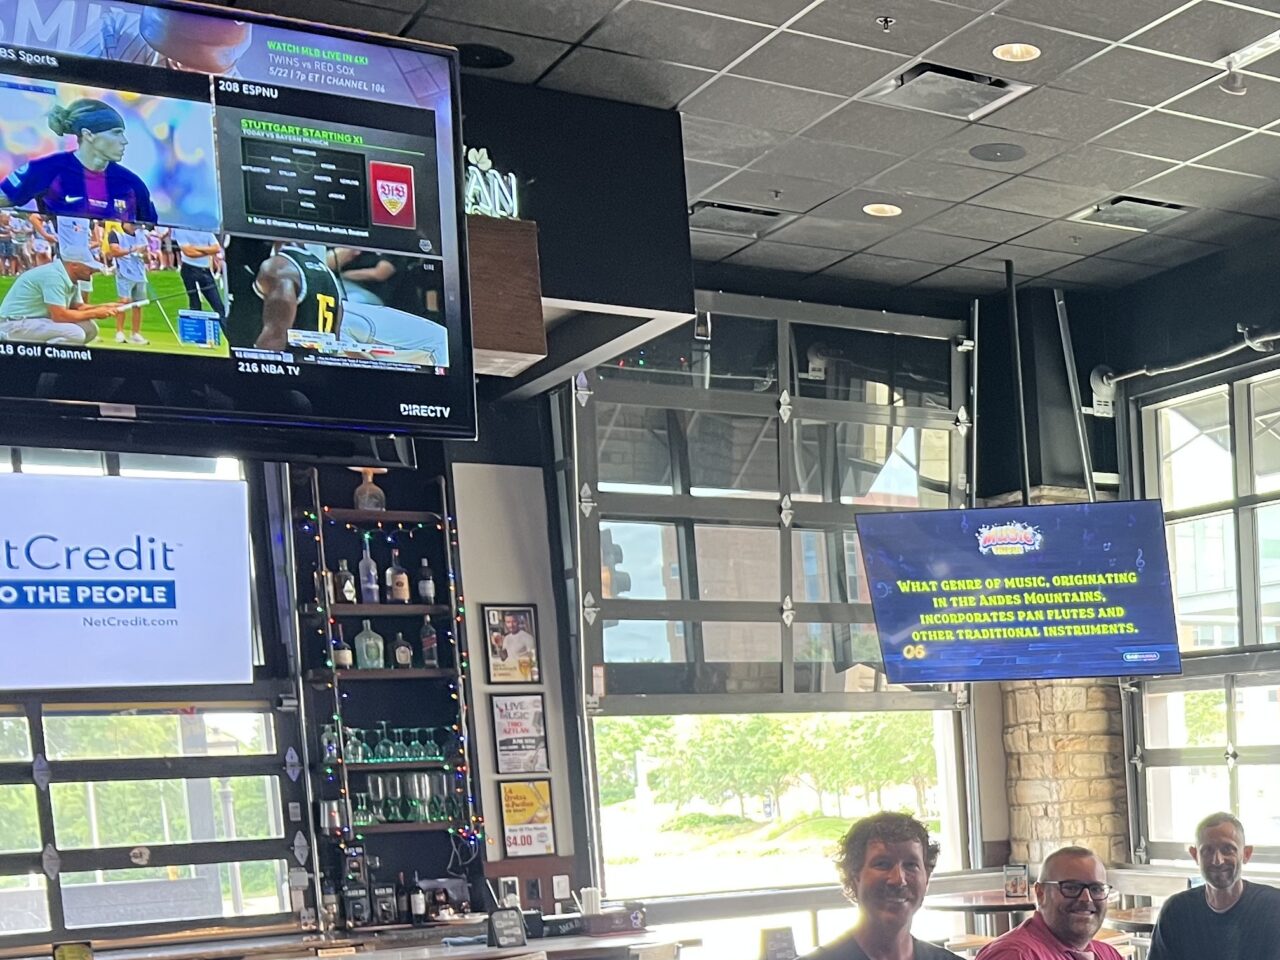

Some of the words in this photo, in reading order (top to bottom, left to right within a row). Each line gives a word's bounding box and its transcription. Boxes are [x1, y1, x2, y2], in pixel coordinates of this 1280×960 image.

[18, 50, 59, 67] Sports
[267, 40, 299, 53] WATCH
[301, 46, 320, 58] MLB
[322, 49, 342, 62] LIVE
[269, 53, 300, 68] TWINS
[302, 59, 312, 69] vs
[314, 60, 334, 74] RED
[336, 64, 355, 77] SOX
[219, 80, 240, 92] 208
[242, 83, 279, 98] ESPNU
[269, 66, 288, 78] 5/22
[308, 71, 319, 82] ET
[326, 75, 368, 91] CHANNEL
[371, 82, 386, 94] 106
[240, 118, 302, 136] STUTTGART
[302, 126, 351, 143] STARTING
[353, 134, 363, 144] XI
[17, 345, 42, 358] Golf
[45, 346, 92, 361] Channel
[238, 361, 259, 373] 216
[261, 363, 284, 375] NBA
[286, 365, 301, 376] TV
[400, 403, 450, 418] DIRECTV
[897, 579, 938, 593] WHAT
[941, 578, 983, 591] GENRE
[985, 578, 1002, 589] OF
[1004, 575, 1050, 589] MUSIC,
[1052, 571, 1138, 587] ORIGINATING
[23, 585, 70, 604] THE
[77, 585, 168, 604] PEOPLE
[933, 596, 948, 608] IN
[950, 595, 977, 607] THE
[980, 593, 1021, 606] ANDES
[82, 616, 179, 628] NetCredit.com
[920, 611, 1015, 625] INCORPORATES
[1018, 609, 1044, 622] PAN
[1047, 607, 1095, 621] FLUTES
[1098, 606, 1125, 619] AND
[911, 629, 955, 642] OTHER
[956, 625, 1041, 640] TRADITIONAL
[1043, 622, 1139, 637] INSTRUMENTS.
[506, 834, 533, 848] $4.00
